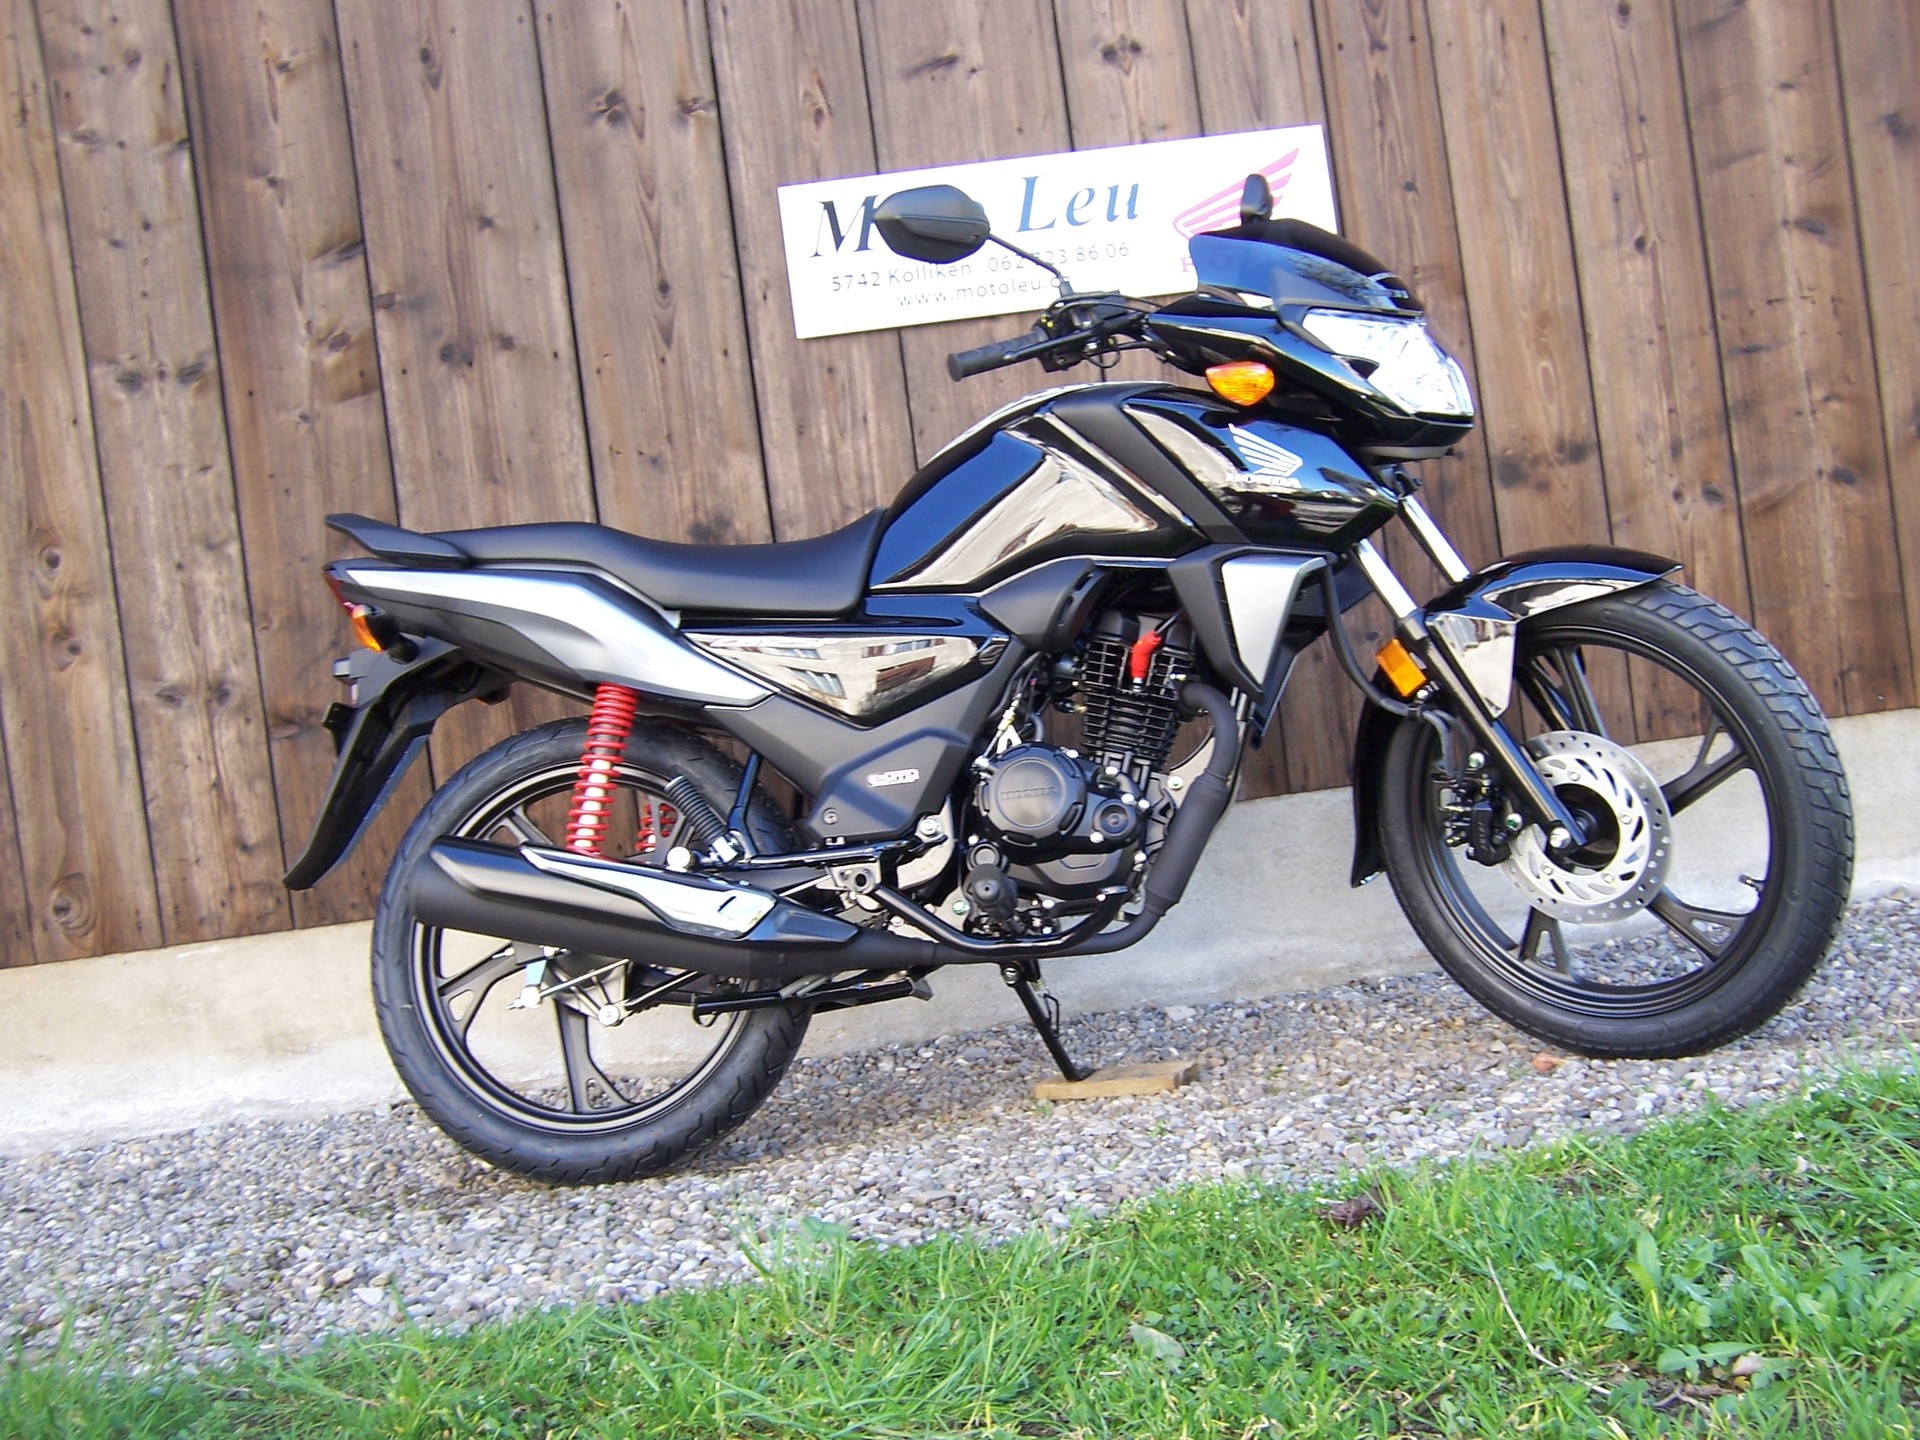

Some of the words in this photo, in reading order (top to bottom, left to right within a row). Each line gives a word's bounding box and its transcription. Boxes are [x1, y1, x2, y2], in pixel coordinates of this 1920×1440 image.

[1015, 175, 1139, 233] Leu
[832, 271, 881, 292] 5742
[988, 254, 1025, 272] 062
[1076, 246, 1099, 262] 86
[1105, 242, 1129, 258] 06
[898, 276, 1070, 306] www.motoleu.c
